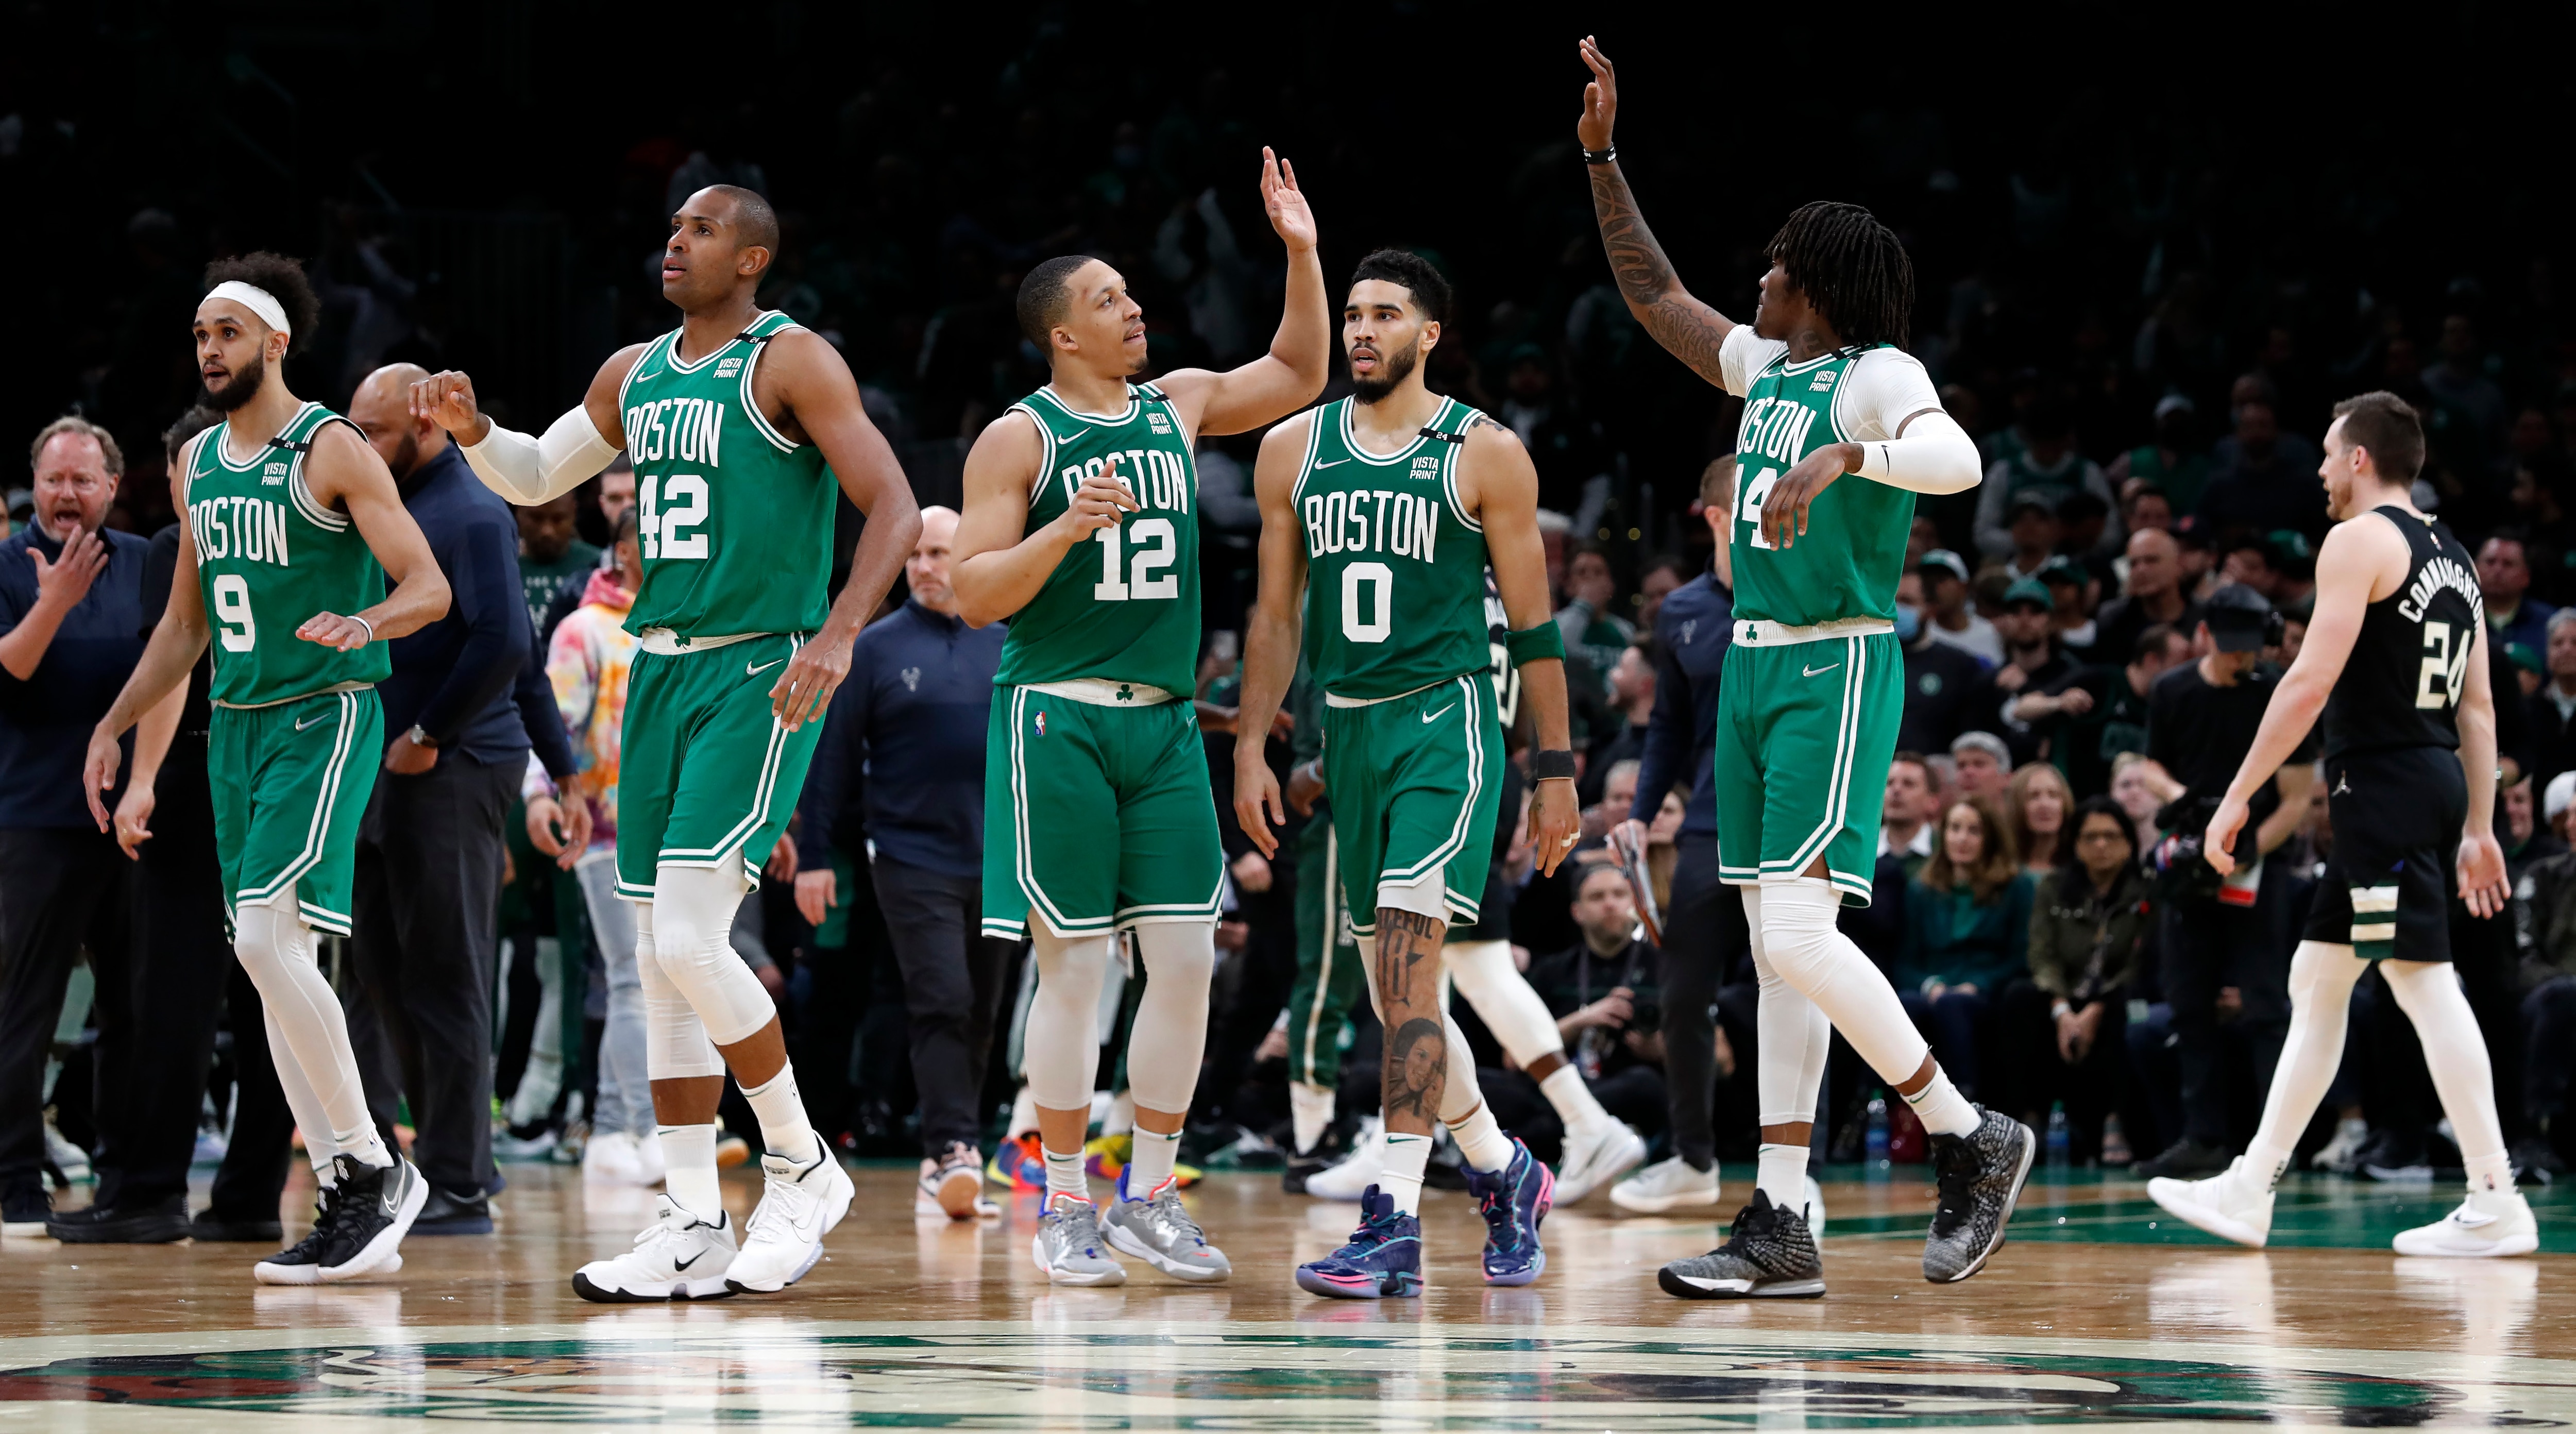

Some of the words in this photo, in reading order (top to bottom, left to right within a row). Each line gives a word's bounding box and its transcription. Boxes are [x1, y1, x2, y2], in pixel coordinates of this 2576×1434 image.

[718, 358, 743, 369] VISTA
[713, 369, 739, 378] PRINT
[1814, 370, 1837, 383] VISTA
[1808, 382, 1832, 392] PRINT
[1146, 413, 1170, 425] VISTA
[626, 397, 724, 468] BOSTON
[1151, 425, 1172, 434] PRINT
[1436, 432, 1448, 441] 24
[284, 441, 295, 449] 24
[264, 463, 288, 477] VISTA
[1412, 457, 1439, 471] VISTA
[261, 476, 284, 486] PRINT
[1409, 469, 1437, 480] PRINT
[639, 475, 709, 559] 42
[189, 496, 289, 567] BOSTON
[1305, 490, 1439, 563] BOSTON
[1094, 518, 1178, 601] 12
[1342, 562, 1393, 643] 0
[2398, 556, 2484, 636] CONNAUGHTO
[213, 575, 256, 652] 9
